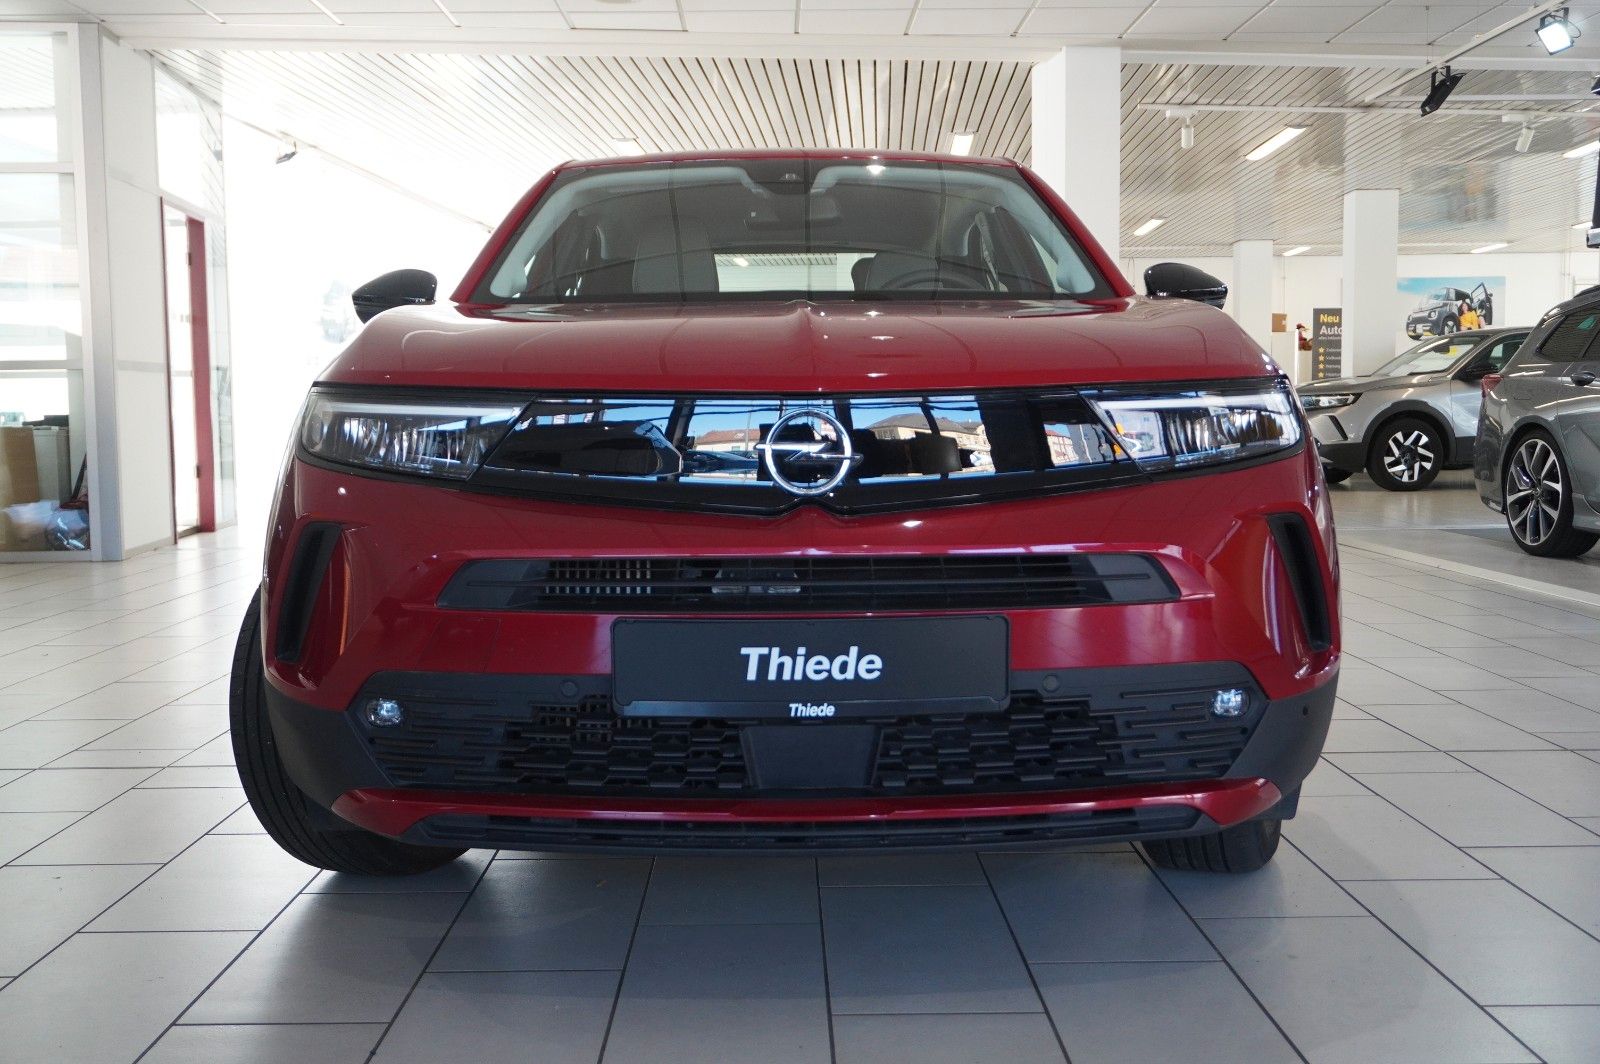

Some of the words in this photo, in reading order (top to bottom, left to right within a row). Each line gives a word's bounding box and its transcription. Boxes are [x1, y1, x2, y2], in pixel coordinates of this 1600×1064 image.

[1320, 313, 1339, 323] Neu
[740, 645, 883, 681] Thiede
[789, 702, 836, 718] Thiede
